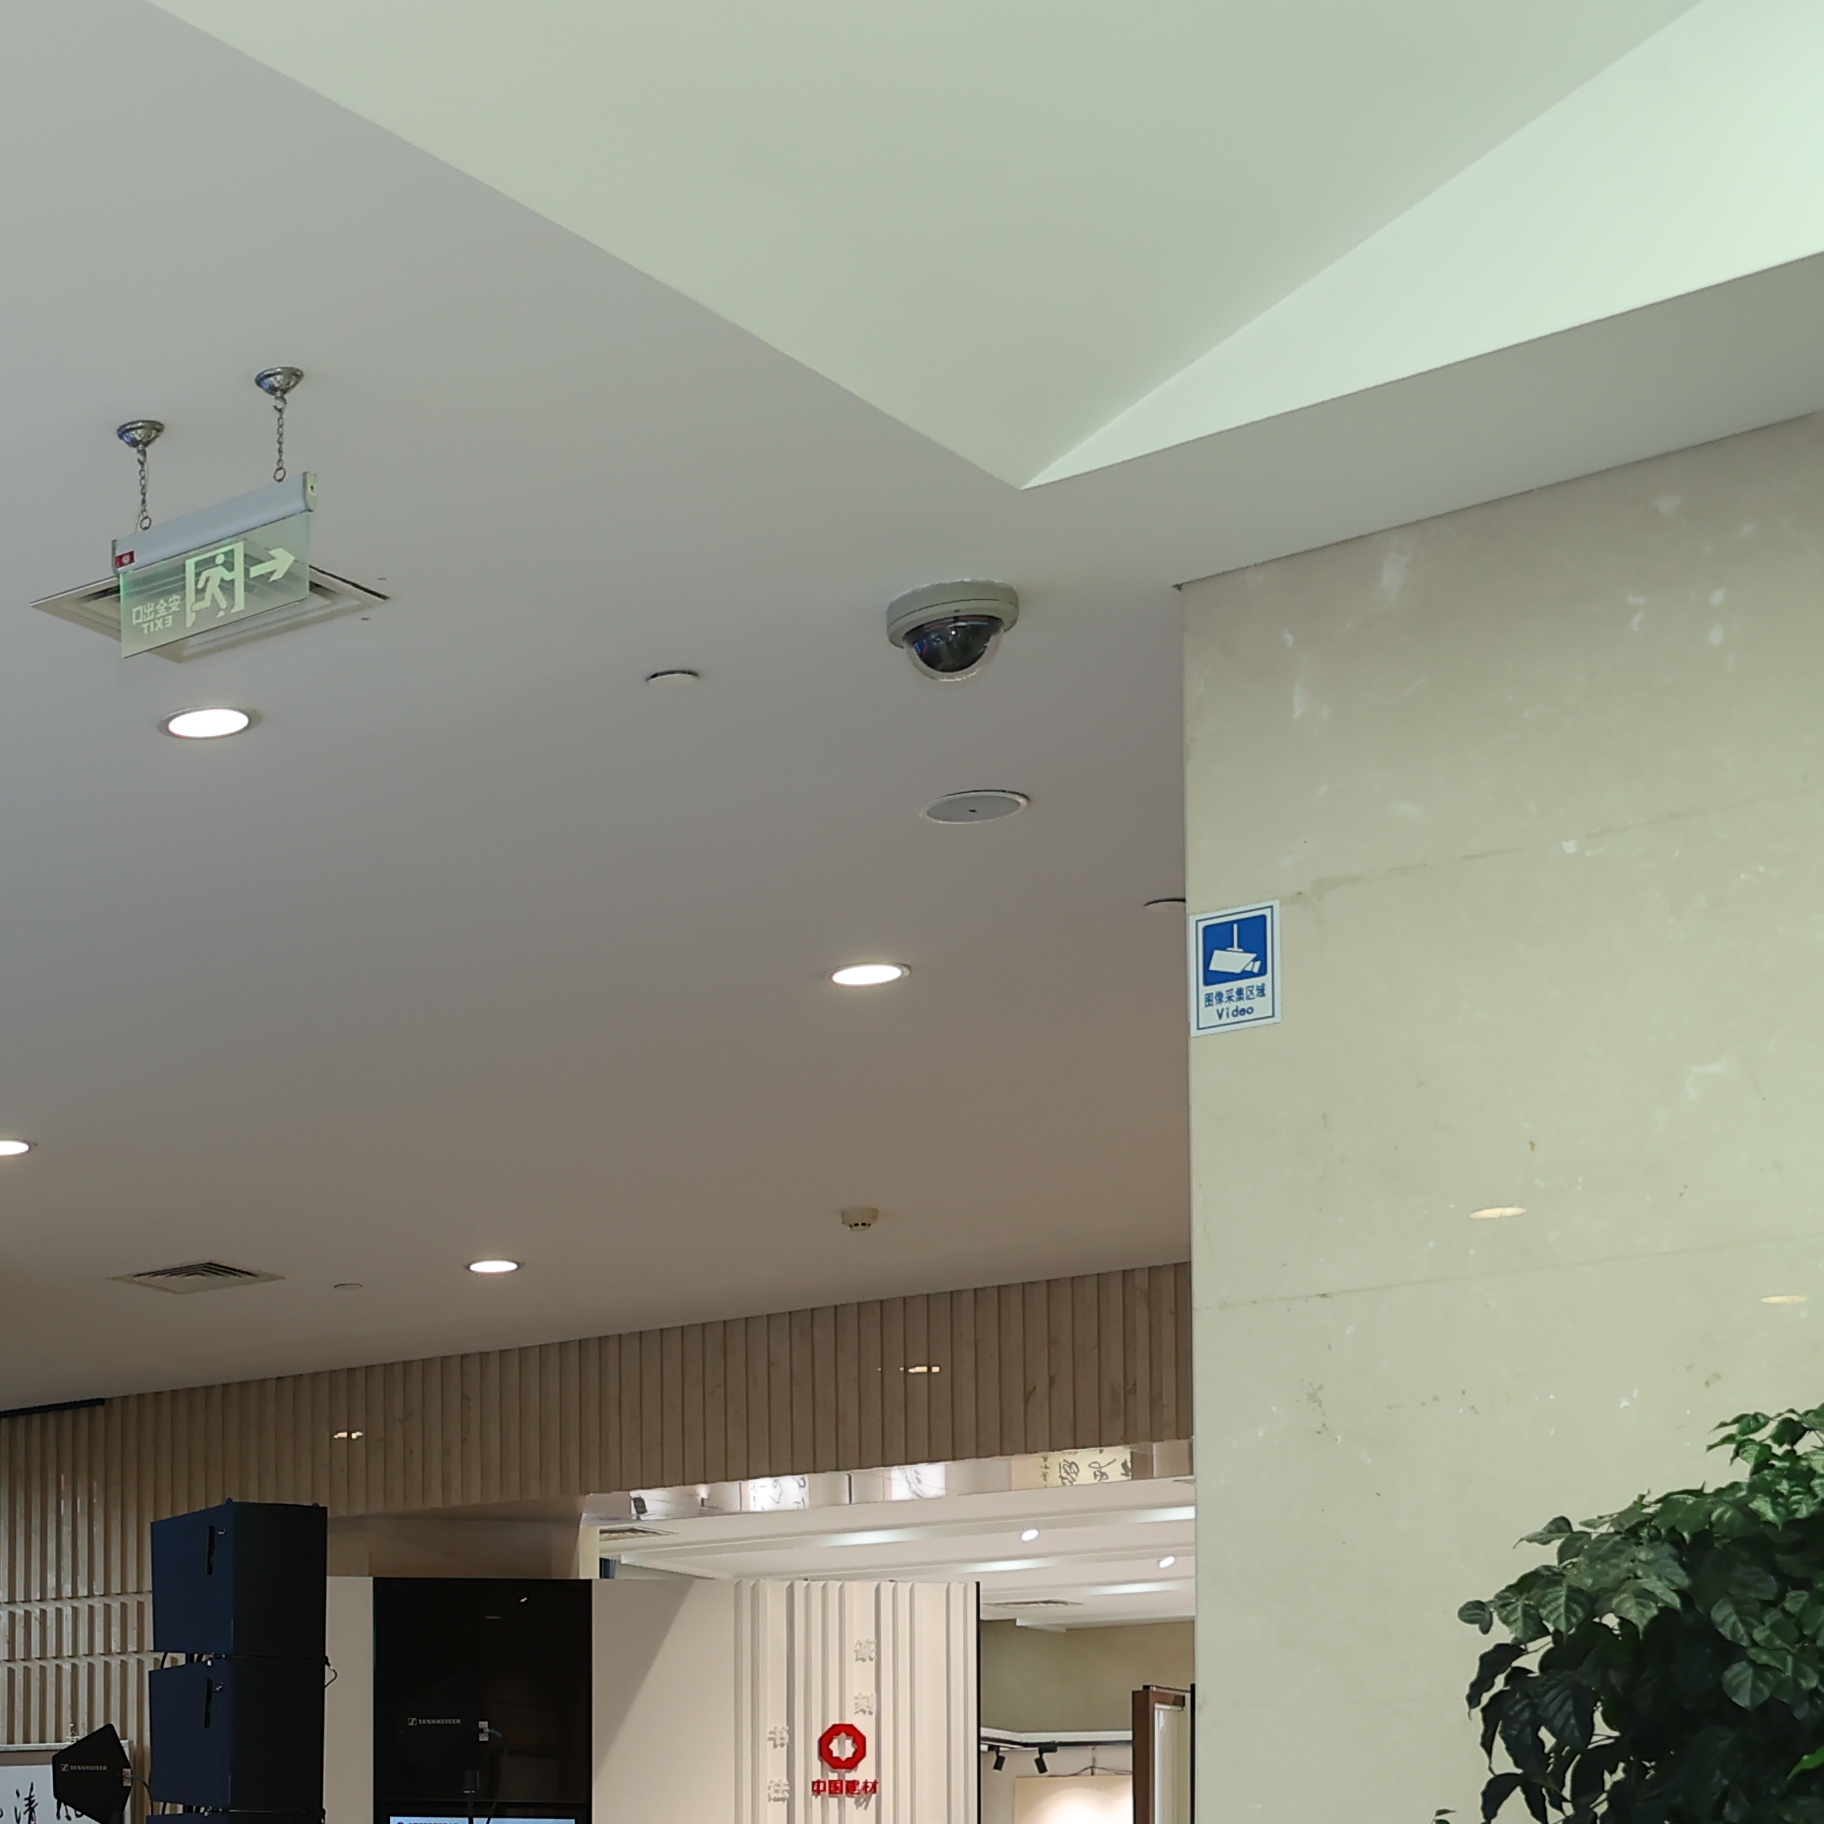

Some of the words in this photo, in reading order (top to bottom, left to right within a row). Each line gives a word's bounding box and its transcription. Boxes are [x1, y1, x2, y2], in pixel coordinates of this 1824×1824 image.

[1205, 982, 1266, 1008] 图像采集区域
[1216, 1005, 1254, 1020] Video
[811, 1779, 879, 1796] 中国建材
